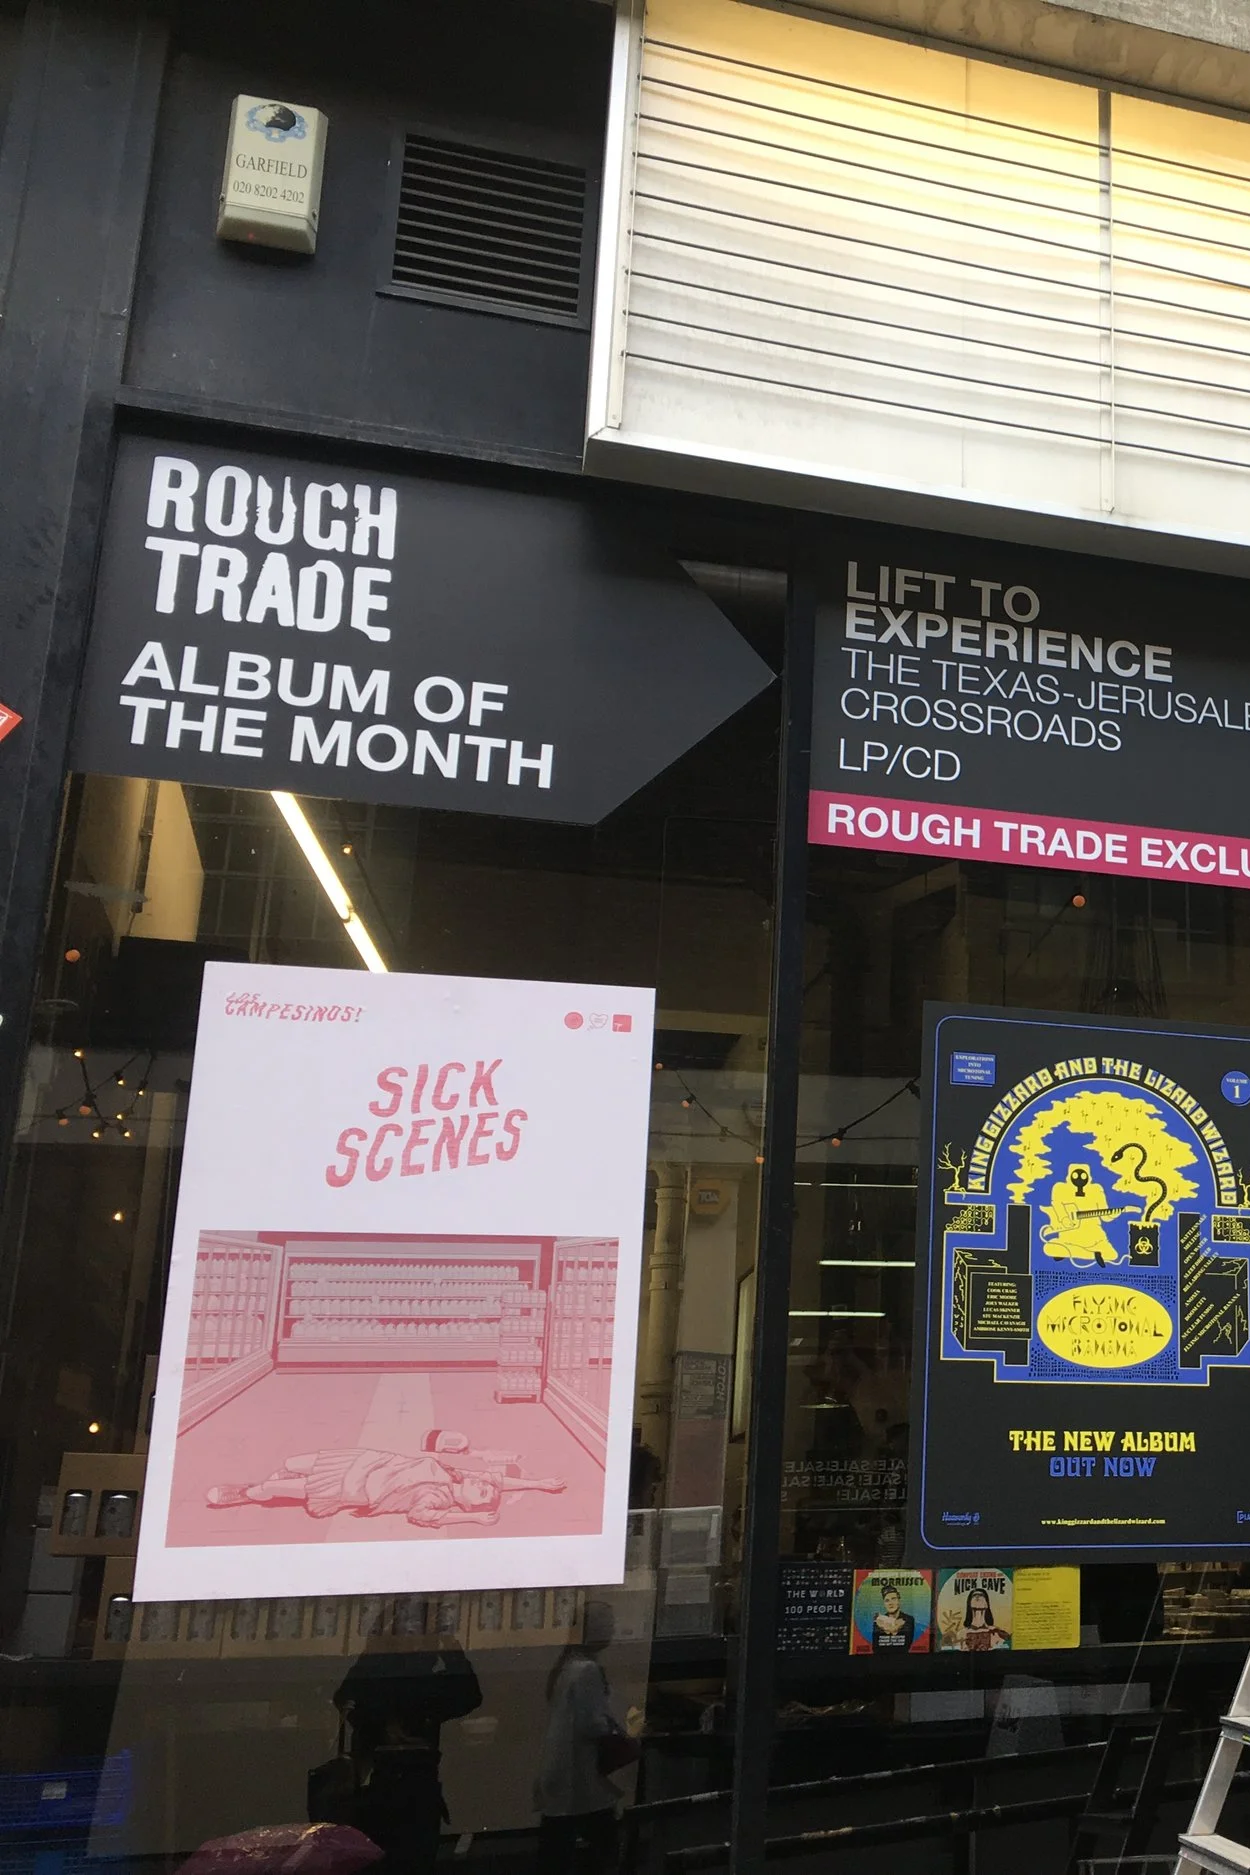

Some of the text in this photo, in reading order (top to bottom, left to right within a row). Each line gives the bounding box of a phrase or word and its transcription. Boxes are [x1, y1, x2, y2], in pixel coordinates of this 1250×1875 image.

[235, 153, 308, 179] GARFIELD
[233, 180, 305, 204] 020 8202 4202
[145, 456, 398, 560] ROUGH
[144, 536, 392, 643] TRADE
[845, 560, 1042, 623] LIFT TO
[844, 601, 1174, 684] EXPERIENCE
[121, 640, 508, 726] ALBUM OF
[841, 647, 921, 688] THE
[119, 695, 555, 789] THE MONTH
[840, 687, 1123, 753] CROSSROADS
[838, 737, 962, 782] LP/CD
[826, 803, 981, 849] ROUGH
[994, 820, 1129, 865] TRADE
[225, 1000, 363, 1023] CAMPESINOS!
[368, 1058, 504, 1118] SICK
[1233, 1085, 1240, 1099] 1
[325, 1108, 529, 1188] SCENES
[967, 1057, 1238, 1205] KING GIZZARD AND THE LIZARD WIZARD
[1009, 1430, 1196, 1452] THE NEW ALBUM
[1050, 1456, 1157, 1478] OUT NOW
[787, 1590, 806, 1599] THE
[872, 1577, 924, 1587] MORRISSEY
[954, 1578, 1006, 1595] NICK CAVE
[785, 1605, 844, 1614] 100 PEOPLE
